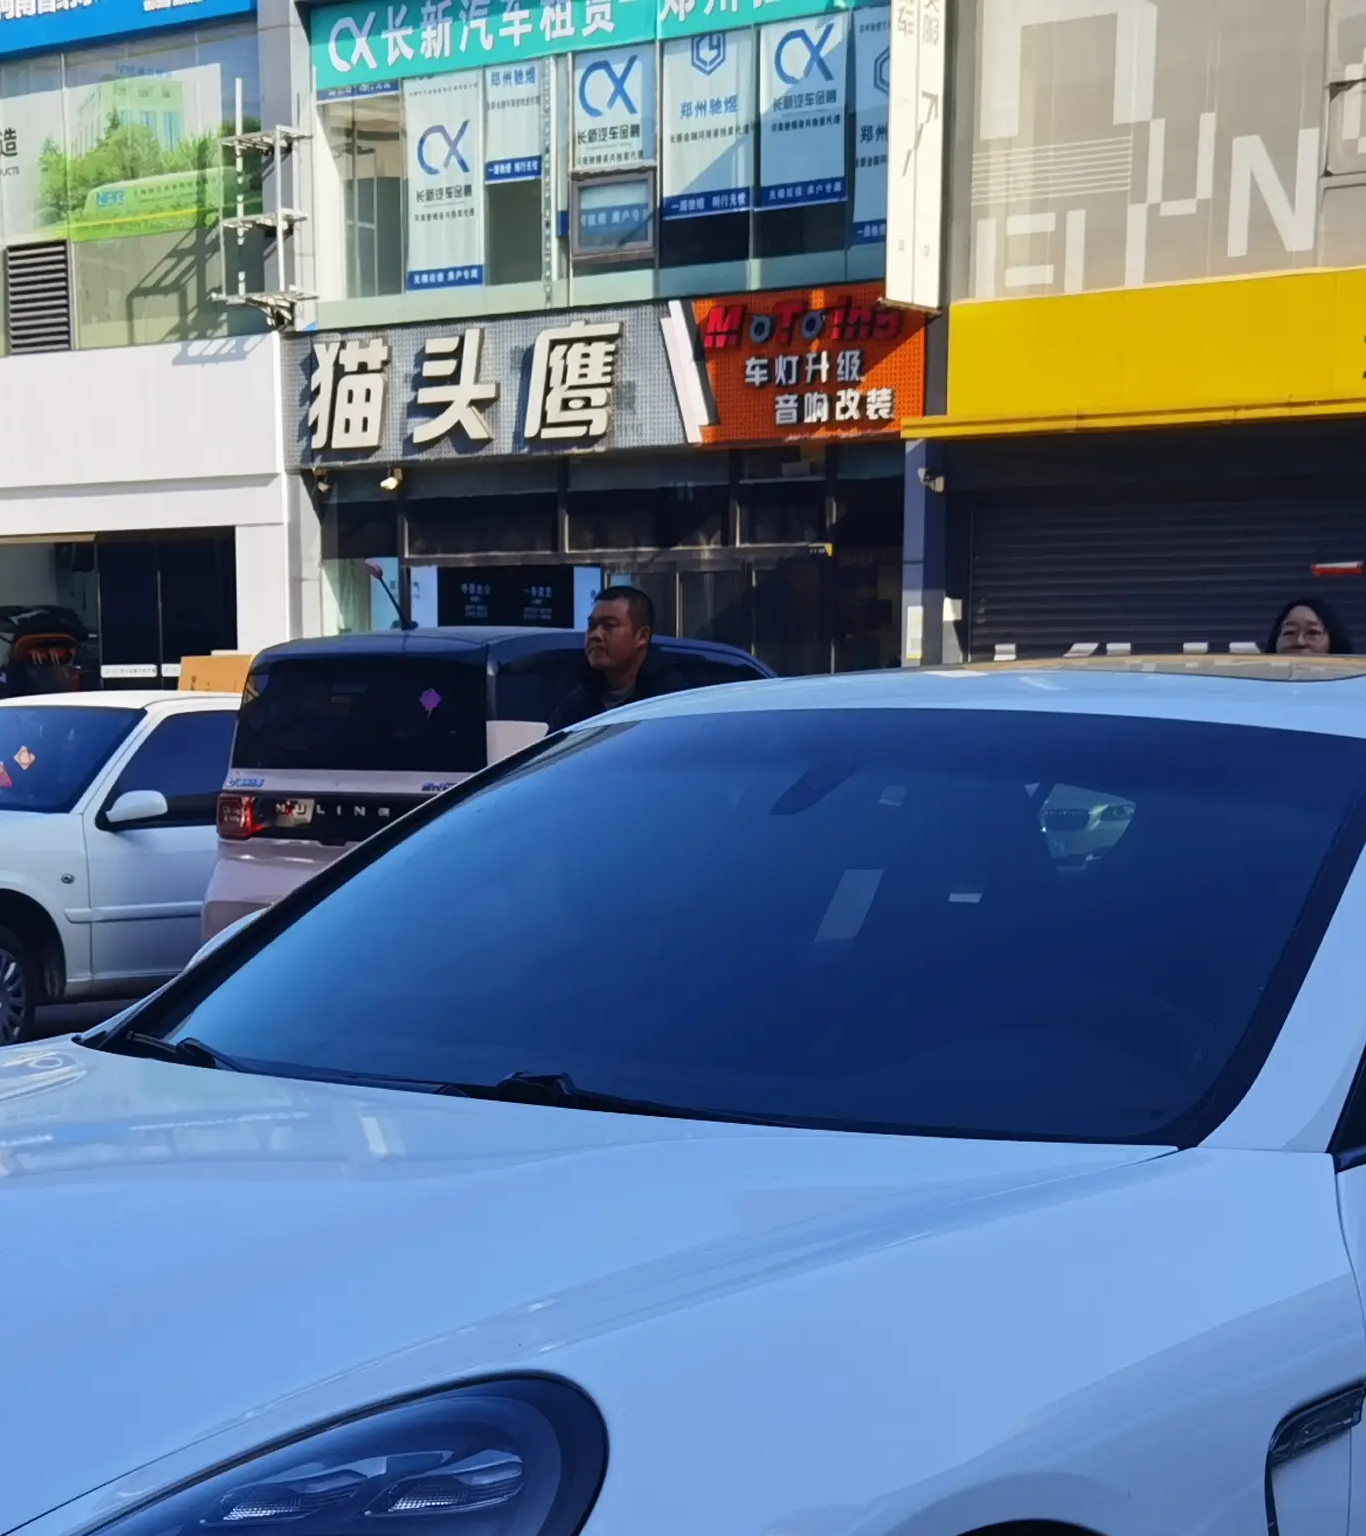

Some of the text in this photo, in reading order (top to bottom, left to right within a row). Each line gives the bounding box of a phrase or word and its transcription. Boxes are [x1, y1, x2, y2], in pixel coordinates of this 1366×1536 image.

[311, 321, 621, 450] 猫头鹰
[745, 350, 865, 388] 车灯升级
[774, 387, 894, 425] 音响改装
